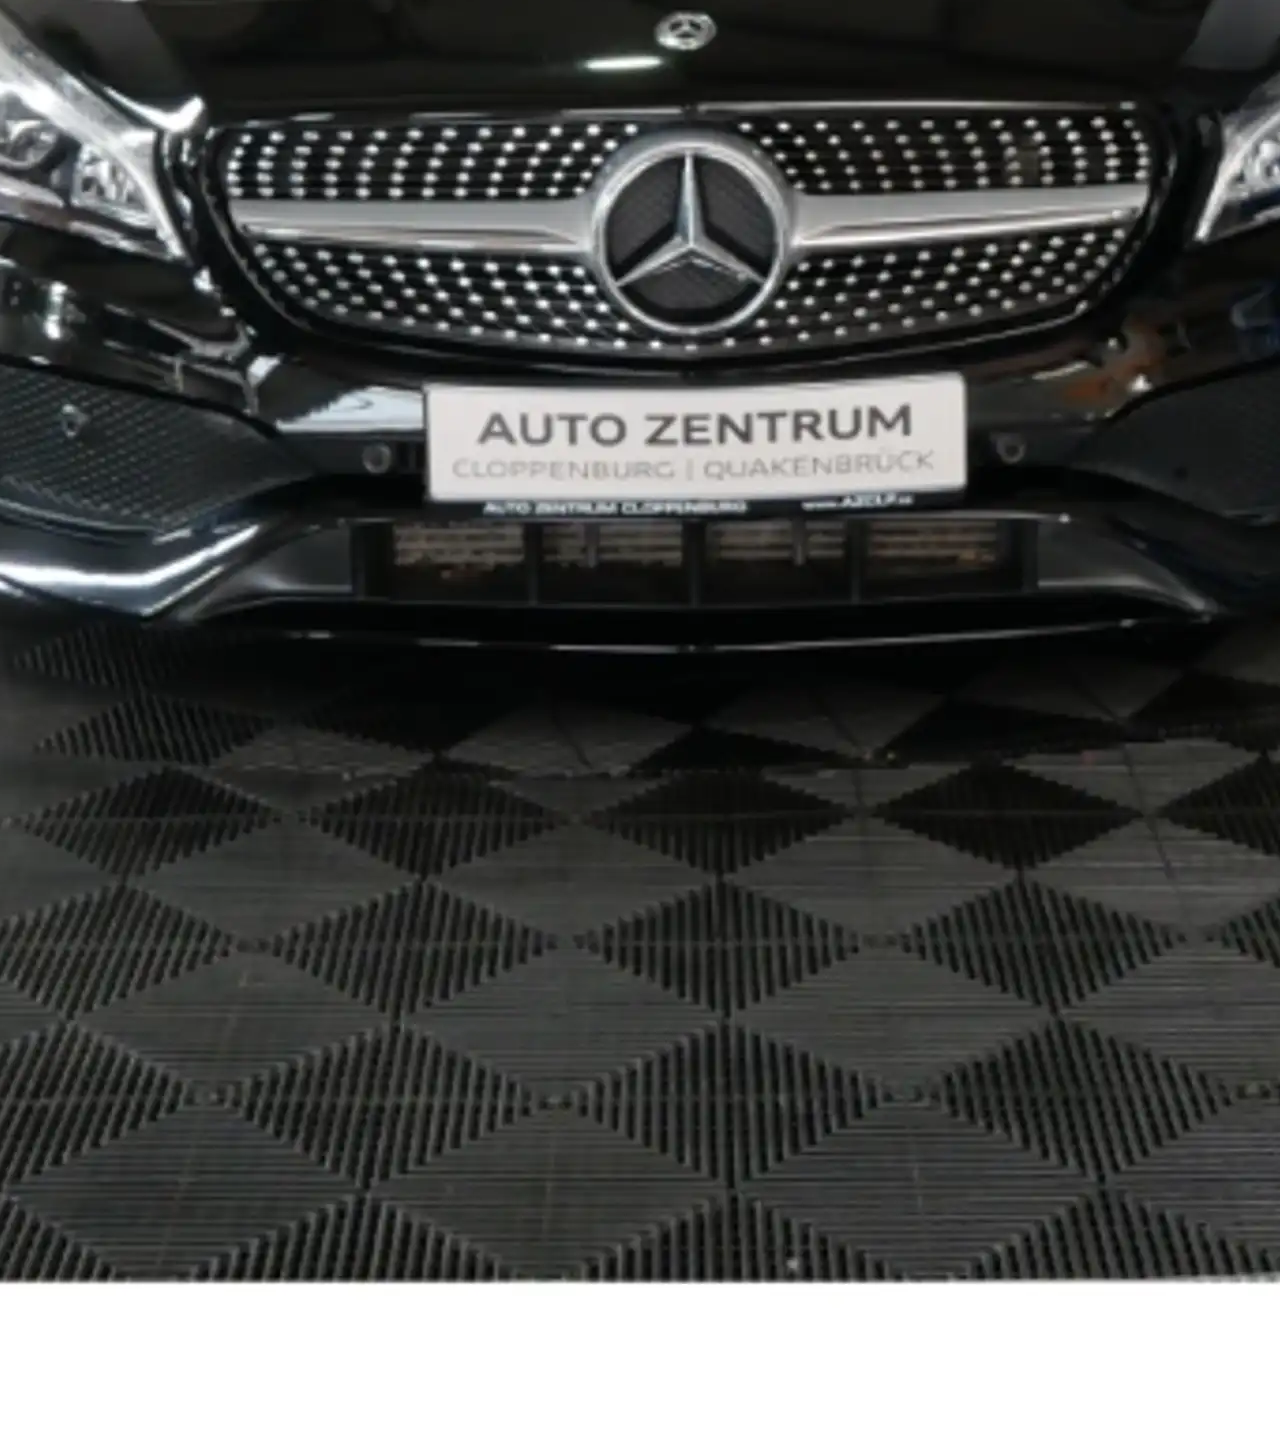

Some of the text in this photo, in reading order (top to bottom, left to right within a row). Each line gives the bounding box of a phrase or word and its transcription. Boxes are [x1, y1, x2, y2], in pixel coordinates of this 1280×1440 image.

[477, 404, 912, 448] AUTO ZENTRUM
[452, 458, 677, 481] CLOPPENBURG
[702, 450, 934, 482] QUAKENBRÜCK
